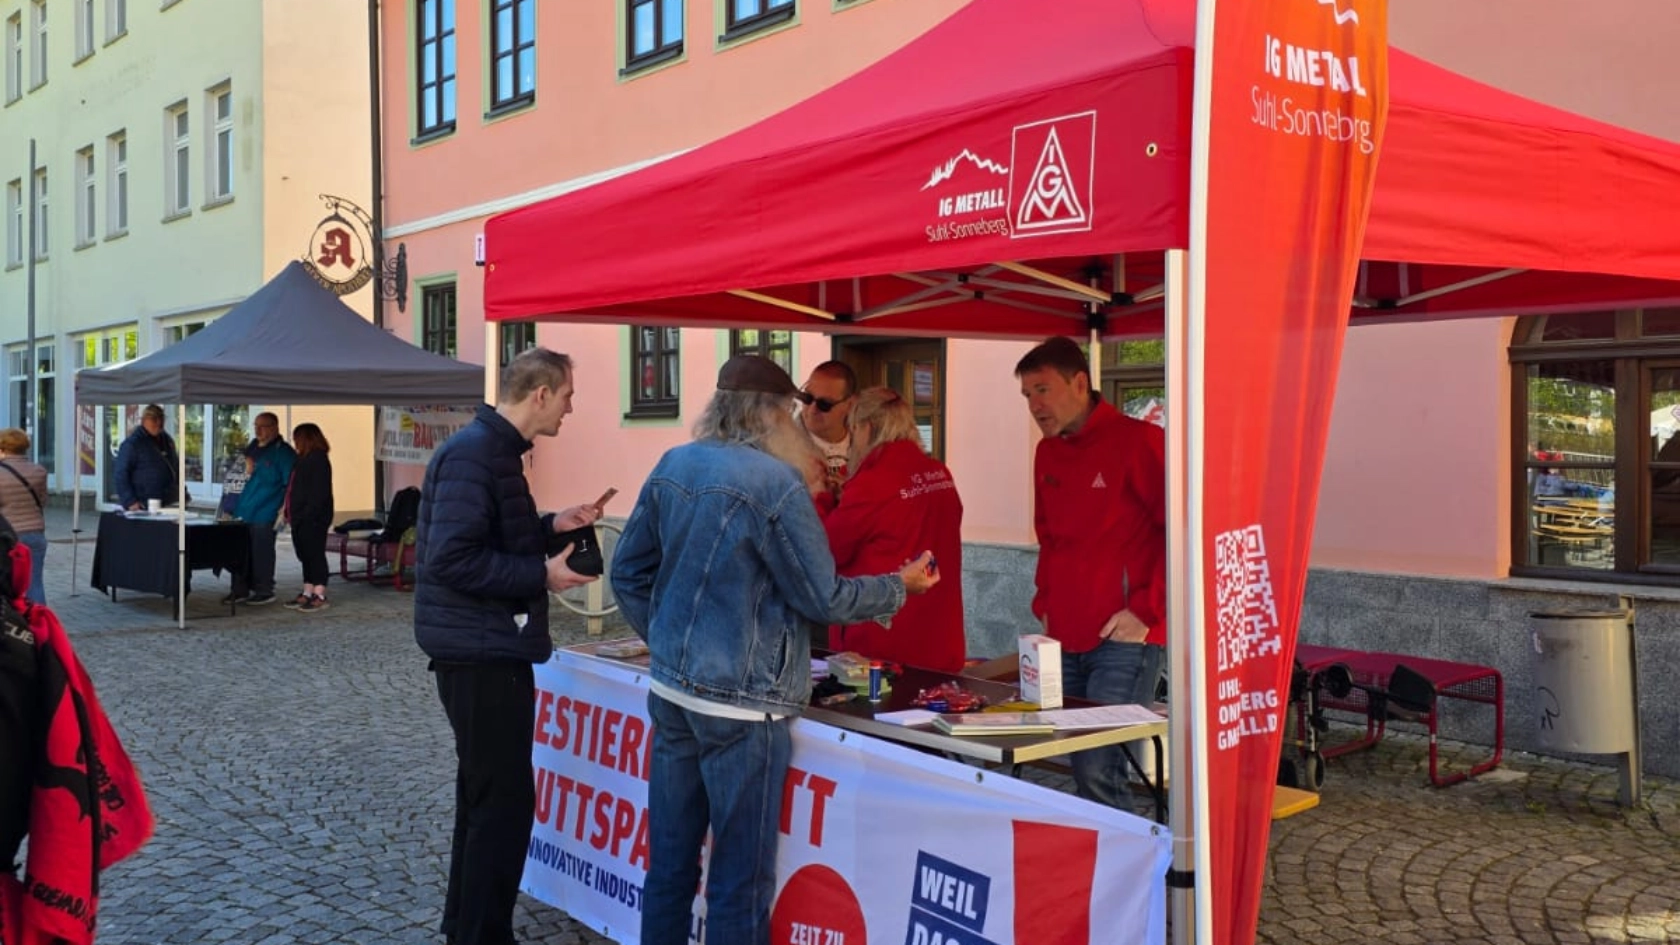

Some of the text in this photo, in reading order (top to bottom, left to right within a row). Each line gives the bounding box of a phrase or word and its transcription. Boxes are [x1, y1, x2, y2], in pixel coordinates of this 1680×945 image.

[1265, 34, 1281, 78] IG
[938, 187, 1005, 217] IG METALL
[925, 217, 1009, 242] Suhl-Sonneberg
[534, 688, 654, 783] ESTIER
[533, 767, 651, 872] UTTSPA
[921, 865, 977, 920] WEIL
